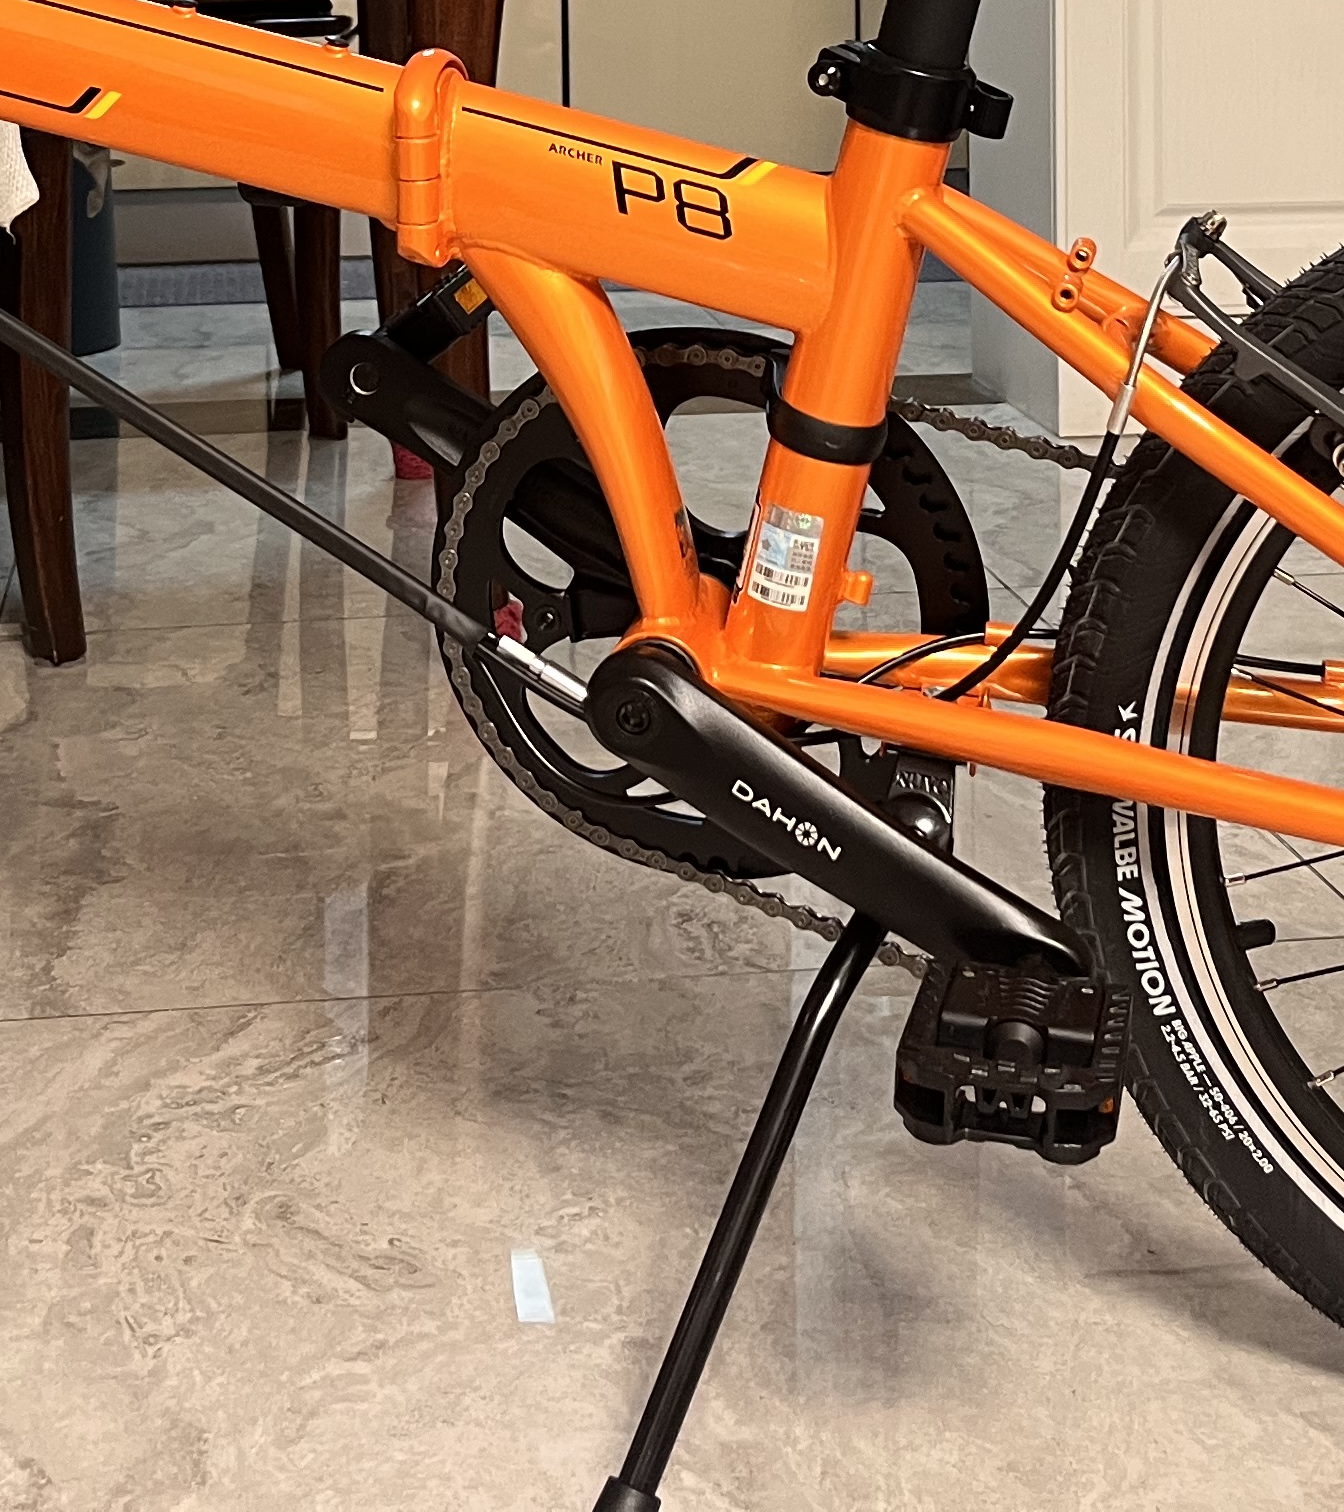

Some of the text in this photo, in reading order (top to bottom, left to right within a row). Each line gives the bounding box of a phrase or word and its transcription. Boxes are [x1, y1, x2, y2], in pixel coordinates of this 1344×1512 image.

[548, 142, 604, 166] ARCHER
[611, 160, 733, 241] P8
[730, 779, 842, 862] DAHON
[1119, 889, 1177, 1018] MOTION
[1181, 1041, 1207, 1073] APPLE
[1217, 1122, 1236, 1141] PSI
